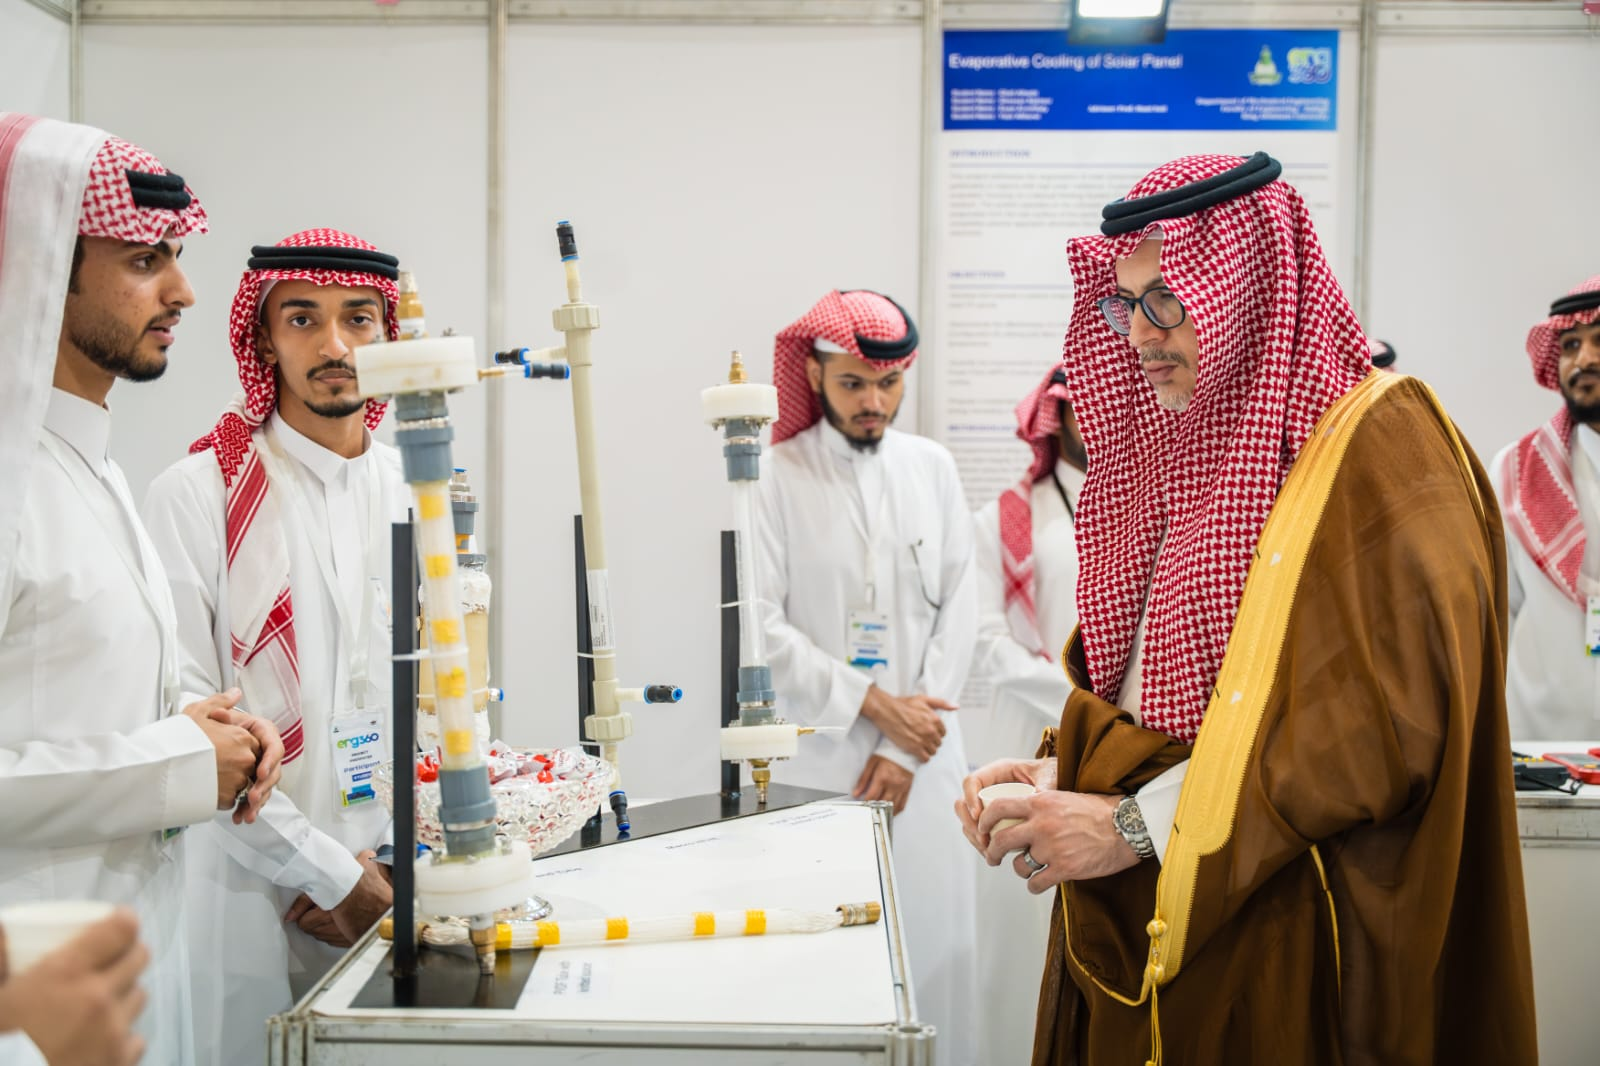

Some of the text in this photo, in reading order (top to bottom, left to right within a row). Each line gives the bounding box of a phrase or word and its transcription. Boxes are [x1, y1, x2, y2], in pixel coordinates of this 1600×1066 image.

[949, 54, 1183, 72] Evaporative Cooling of Solar Panel
